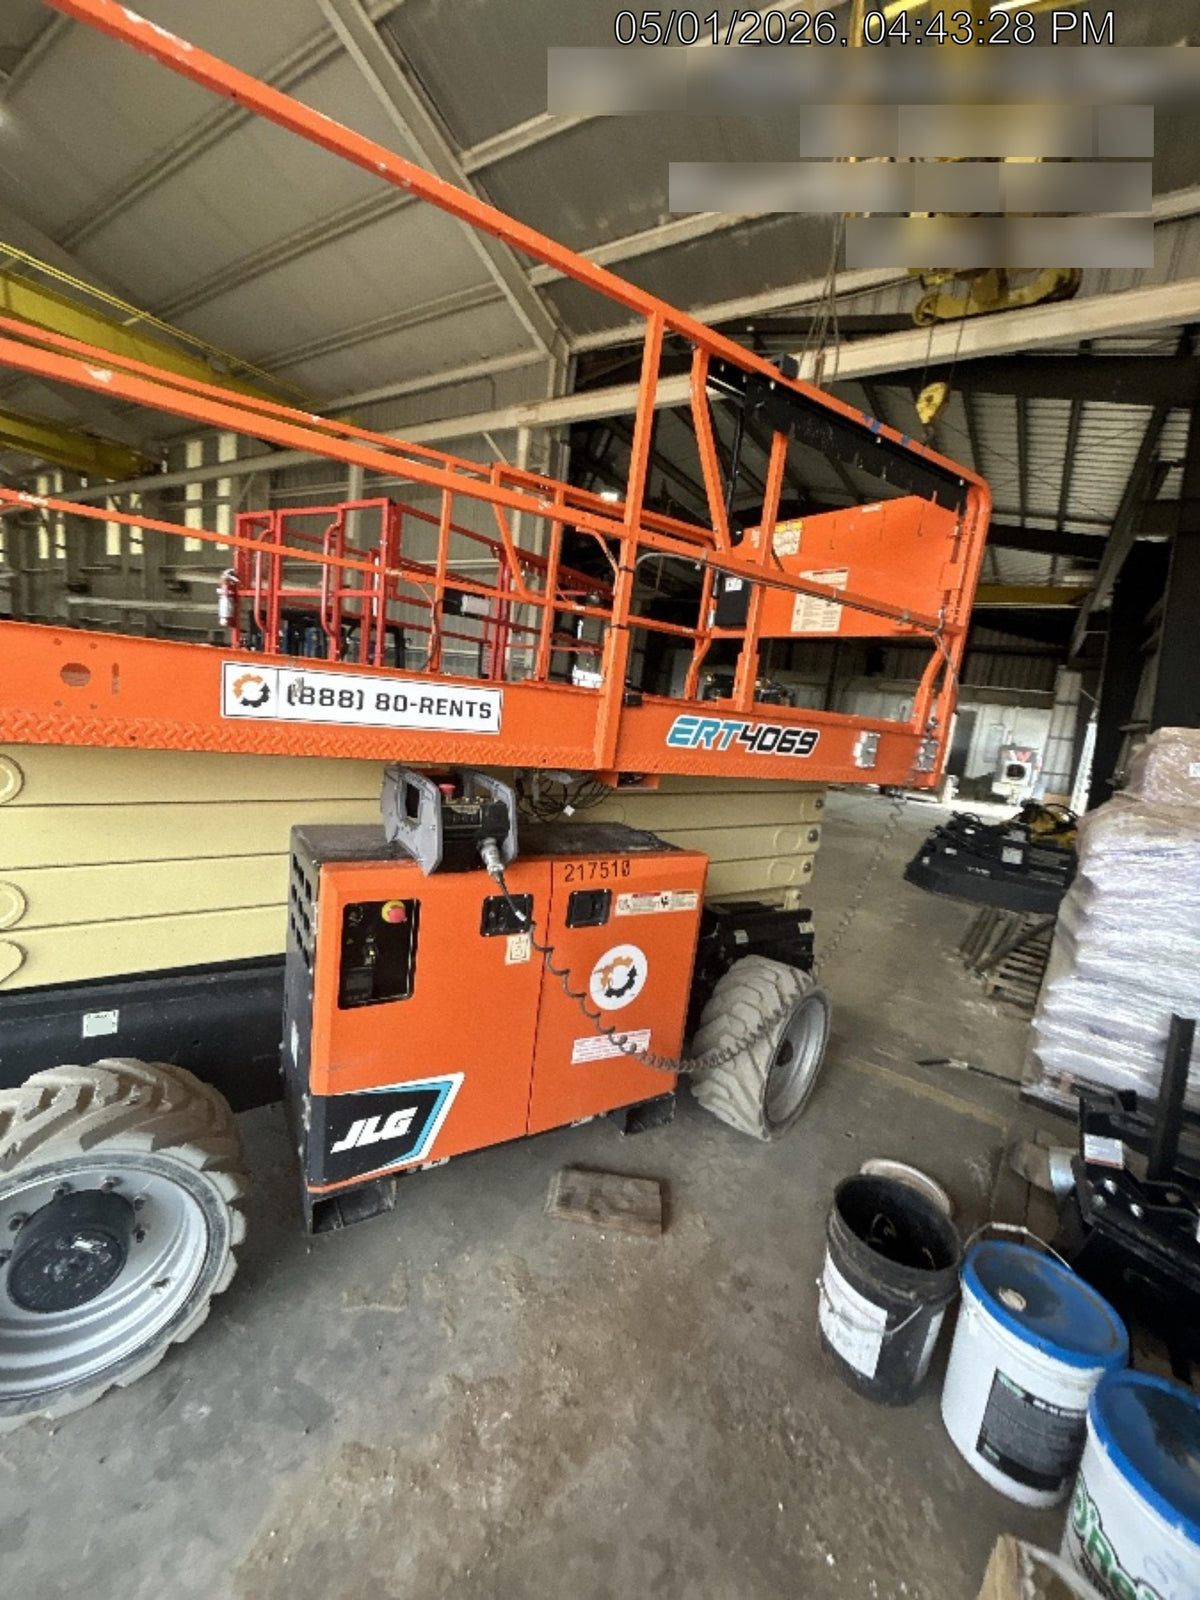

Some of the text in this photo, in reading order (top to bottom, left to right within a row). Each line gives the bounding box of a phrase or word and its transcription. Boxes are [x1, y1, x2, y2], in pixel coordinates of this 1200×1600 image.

[375, 692, 492, 719] 80-RENTS
[667, 715, 820, 757] ERT4069
[330, 1106, 419, 1154] JLG
